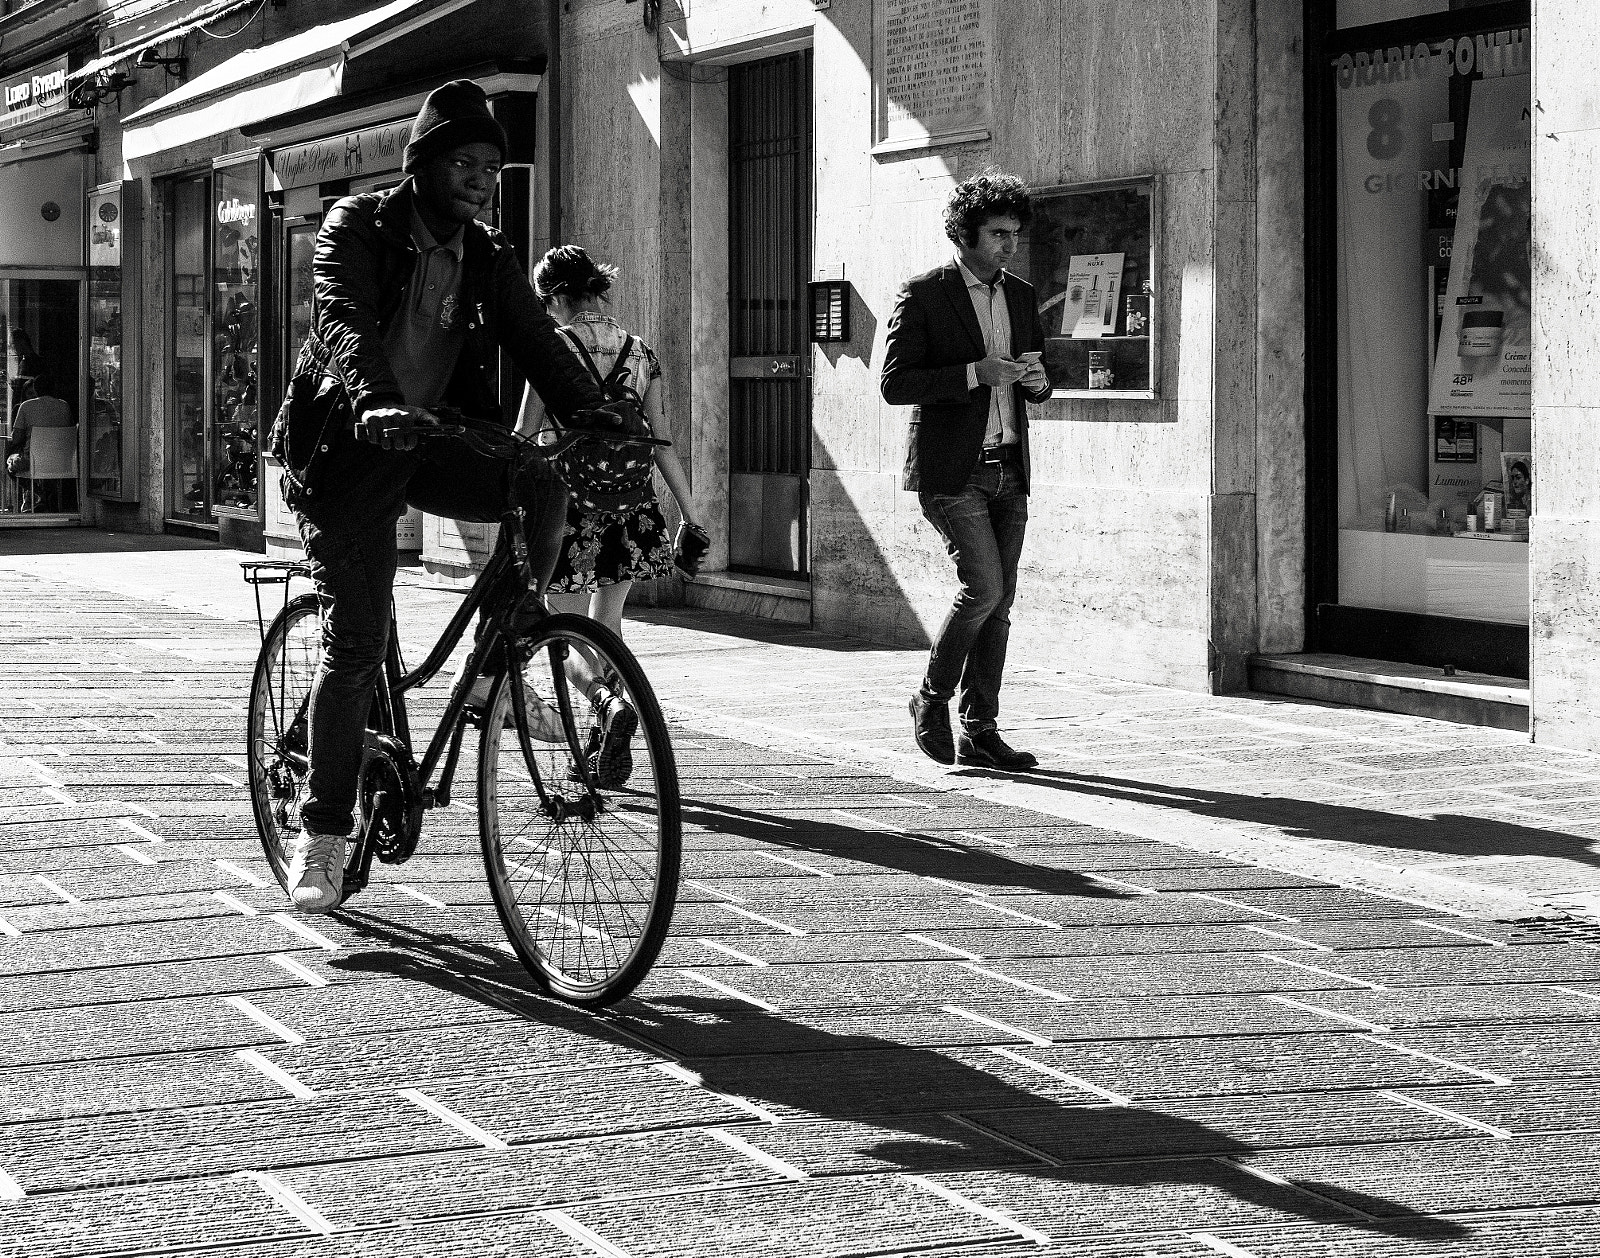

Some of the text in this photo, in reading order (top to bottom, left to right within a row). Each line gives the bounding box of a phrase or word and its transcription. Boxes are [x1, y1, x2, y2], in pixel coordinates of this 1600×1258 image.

[1336, 43, 1430, 89] ORARIO
[5, 69, 65, 106] LORD BYRON
[369, 128, 395, 160] Nails
[1366, 98, 1403, 161] 8
